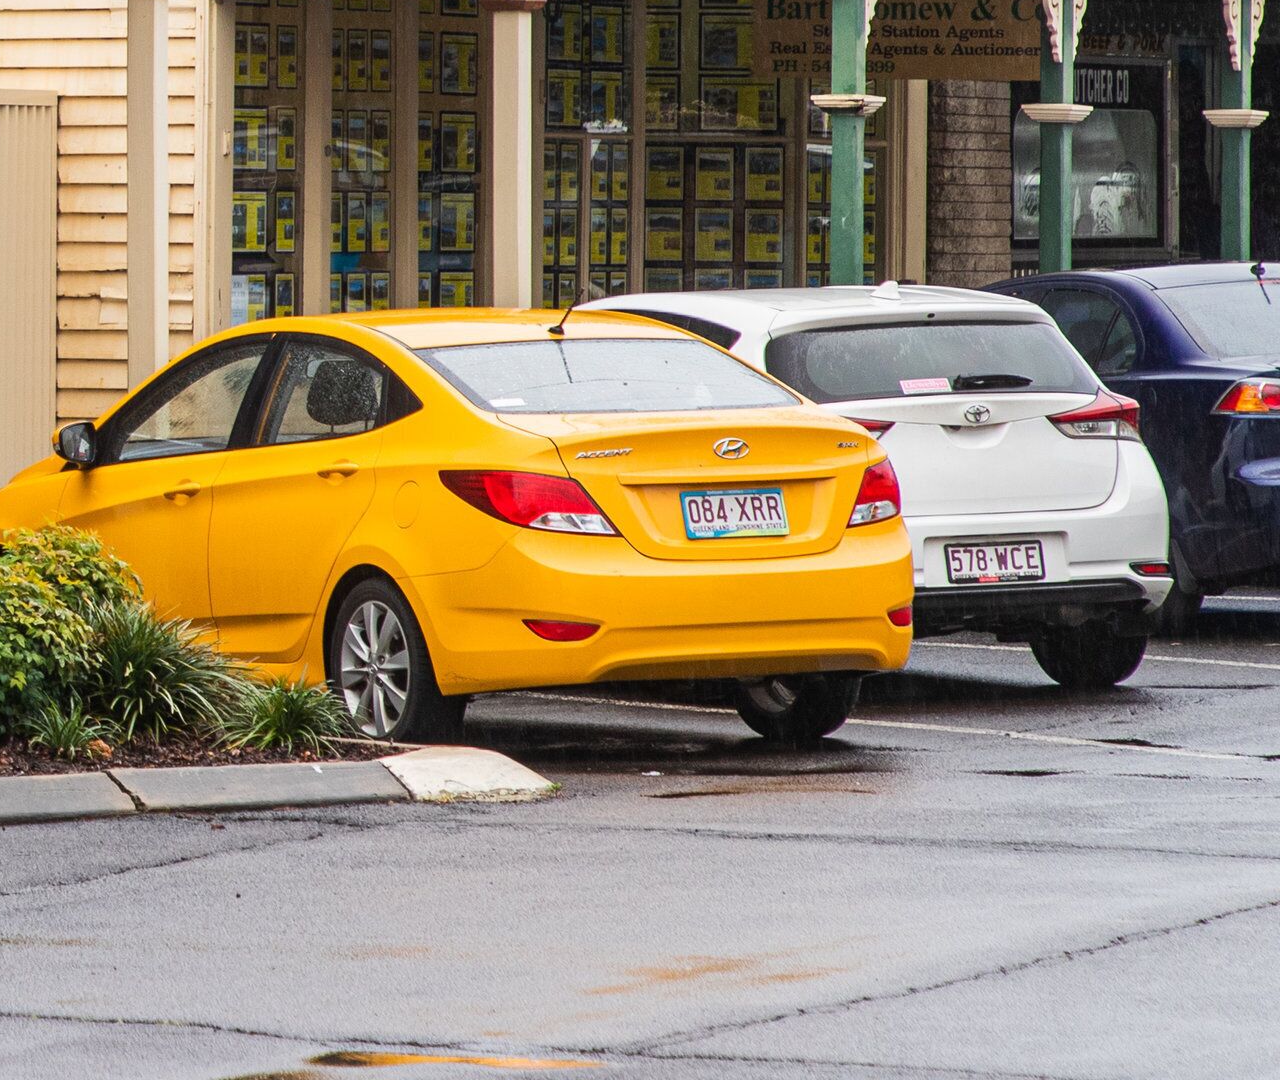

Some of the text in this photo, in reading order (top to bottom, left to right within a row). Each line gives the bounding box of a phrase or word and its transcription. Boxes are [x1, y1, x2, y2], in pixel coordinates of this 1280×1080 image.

[882, 25, 1004, 41] Station Agents
[769, 42, 806, 55] Real
[871, 42, 928, 58] Agents
[933, 43, 949, 56] &
[951, 42, 1041, 56] Auctioneer
[1074, 69, 1130, 104] UTCHER CO
[575, 448, 633, 459] ACCENT
